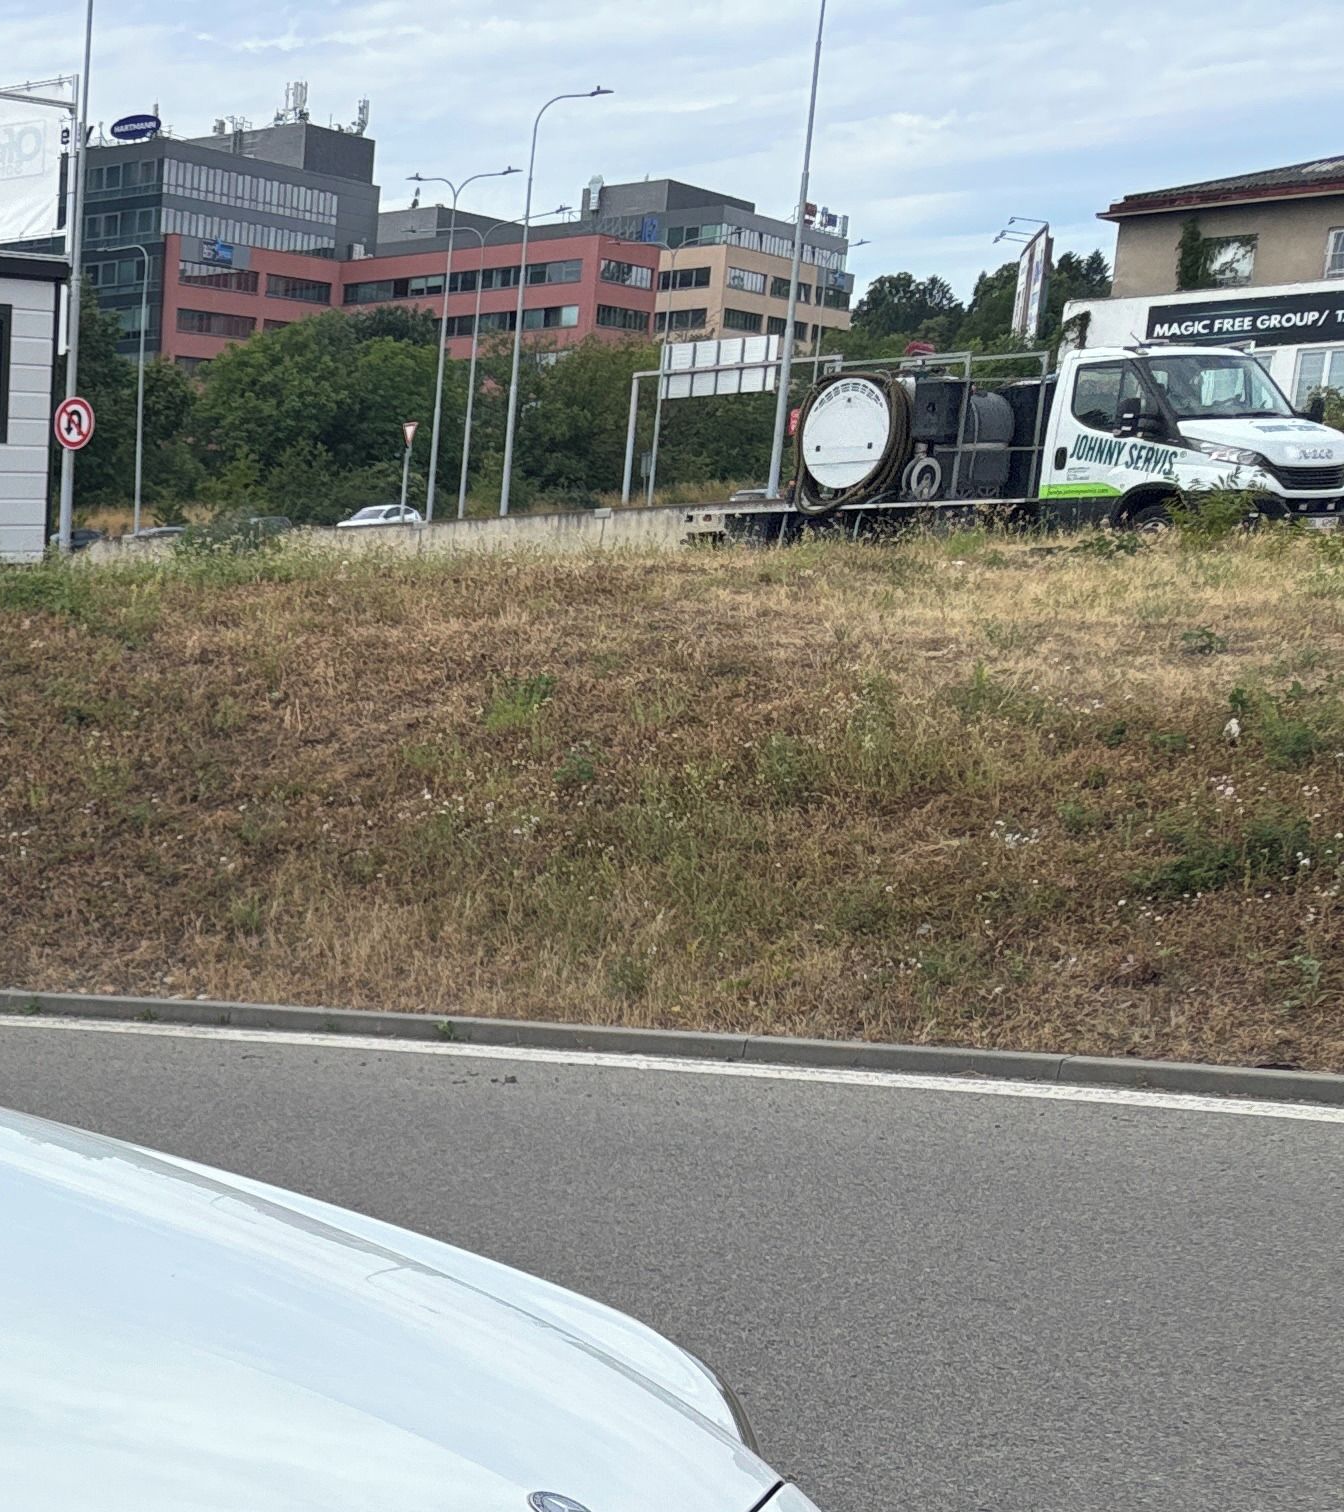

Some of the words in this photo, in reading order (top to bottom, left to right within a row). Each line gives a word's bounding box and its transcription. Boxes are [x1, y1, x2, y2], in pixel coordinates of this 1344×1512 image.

[113, 121, 157, 133] HARTMANN
[1153, 320, 1210, 337] MAGIC
[1212, 316, 1253, 333] FREE
[1069, 433, 1127, 467] JOHNNY
[1124, 443, 1178, 476] SERVIS
